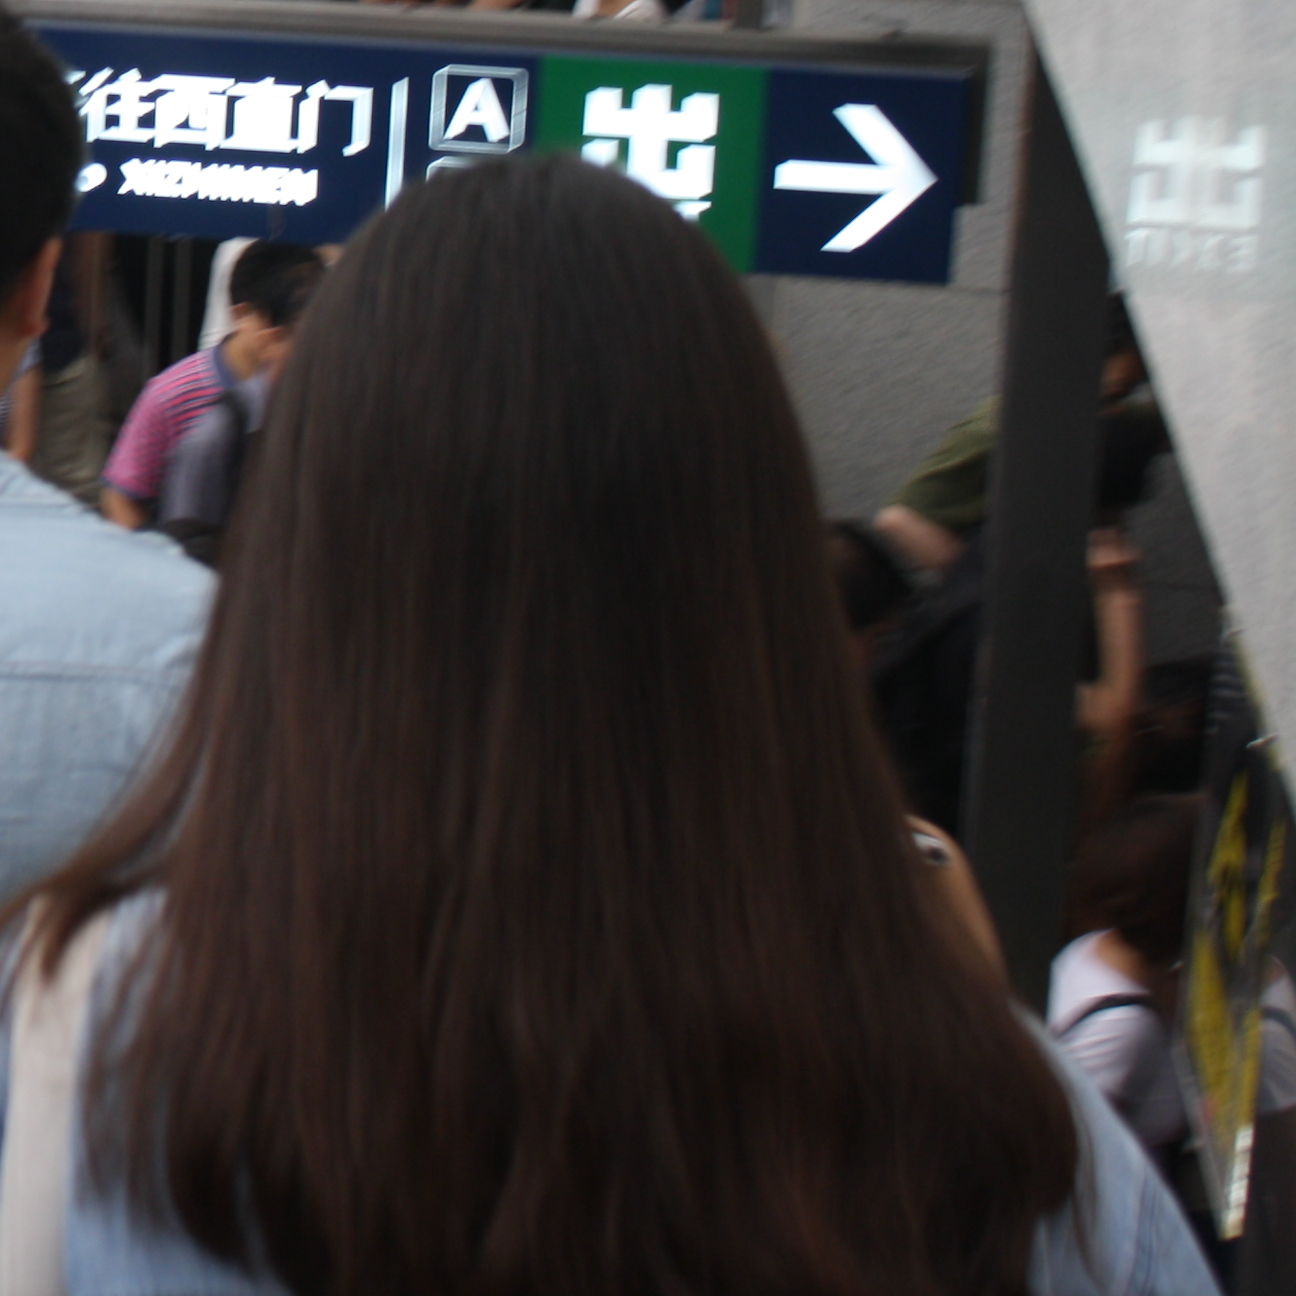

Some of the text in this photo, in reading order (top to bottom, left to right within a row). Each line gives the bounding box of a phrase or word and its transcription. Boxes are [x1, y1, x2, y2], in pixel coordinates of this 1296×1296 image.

[64, 67, 510, 157] 往西直门 A
[581, 83, 720, 200] 出
